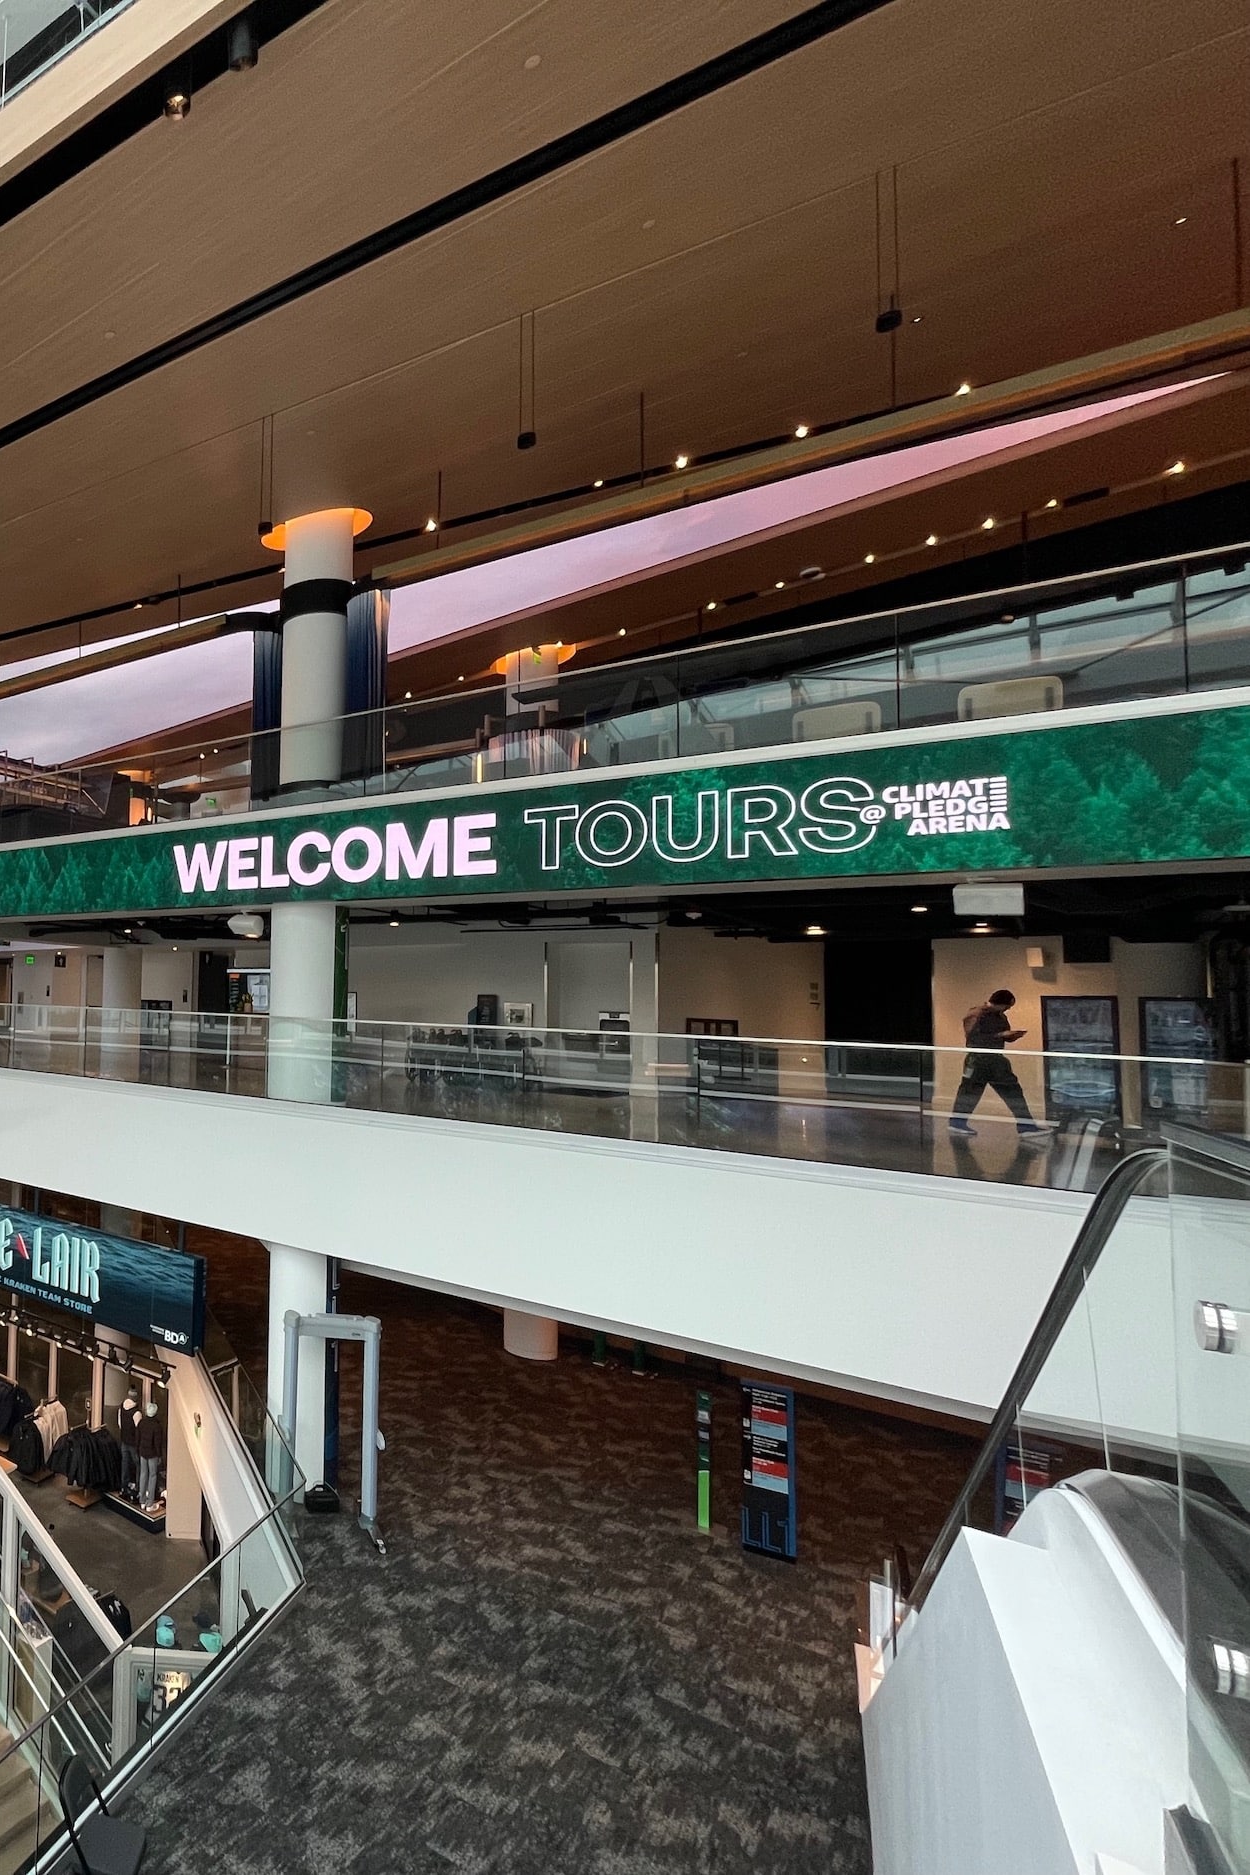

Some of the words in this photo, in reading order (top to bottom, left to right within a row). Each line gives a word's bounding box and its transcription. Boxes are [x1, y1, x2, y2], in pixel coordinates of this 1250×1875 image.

[882, 776, 1007, 803] CLIMATE
[859, 805, 886, 824] @
[894, 795, 1007, 820] PLEDGE
[173, 812, 497, 893] WELCOME
[524, 777, 877, 870] TOURS
[907, 812, 1011, 836] ARENA
[31, 1227, 100, 1304] LAIR
[3, 1276, 37, 1294] KRAKEN
[37, 1288, 62, 1304] TEAM
[63, 1297, 93, 1315] STORE
